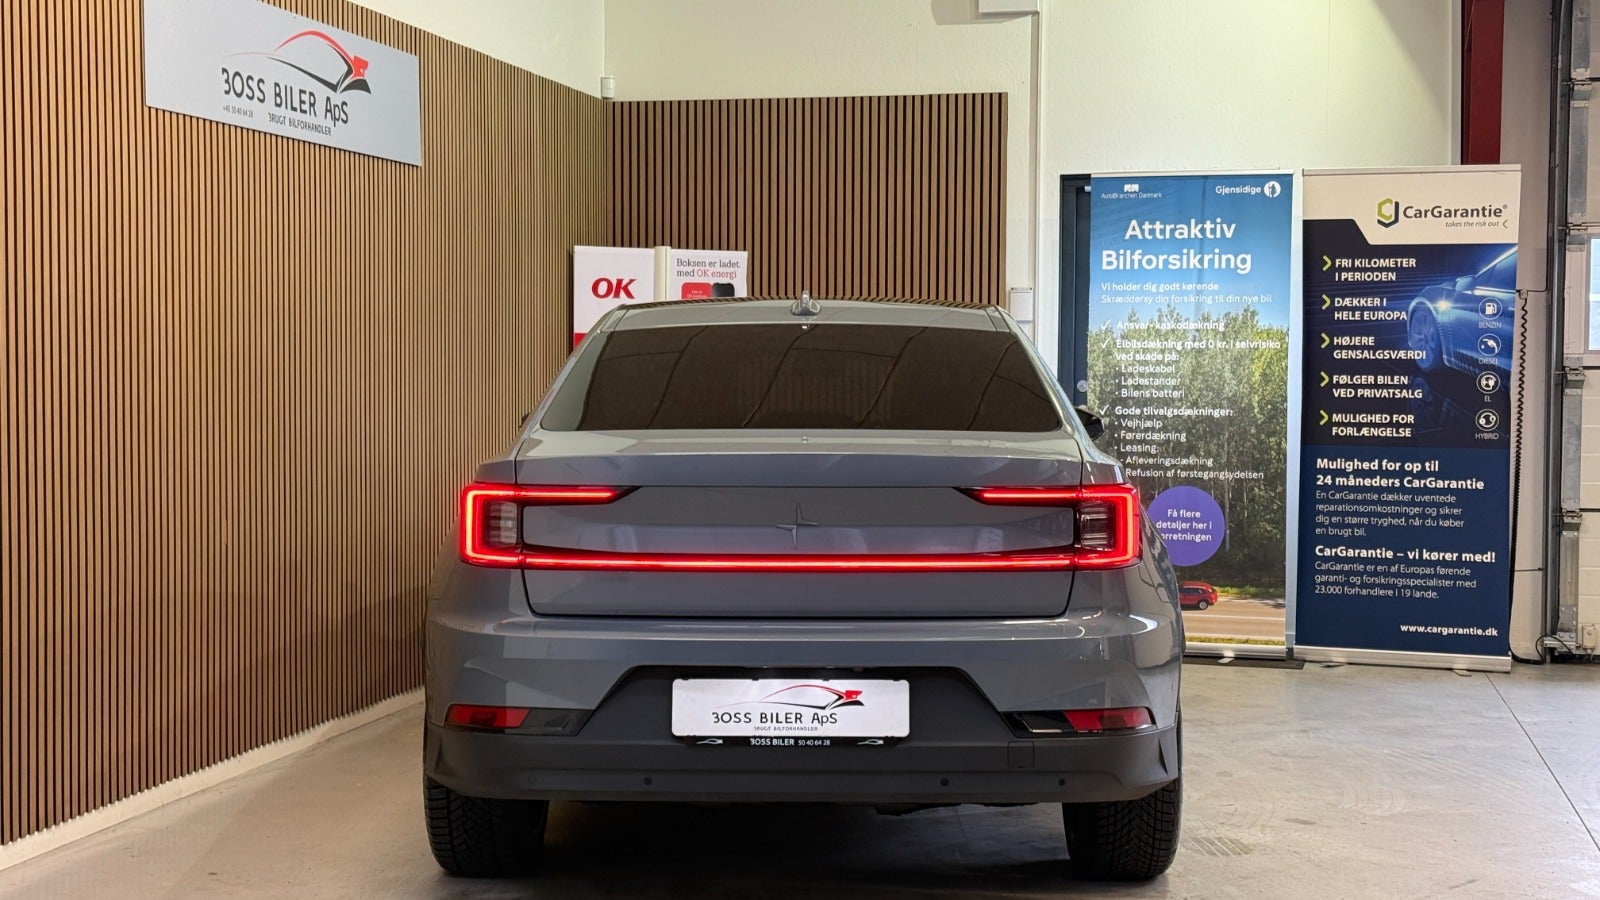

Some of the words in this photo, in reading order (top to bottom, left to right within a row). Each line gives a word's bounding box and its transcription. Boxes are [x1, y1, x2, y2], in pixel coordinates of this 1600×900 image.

[274, 82, 317, 118] BILER
[324, 96, 348, 127] ApS
[288, 117, 332, 136] BILFORHANDLER
[1215, 185, 1262, 196] Gjensidige
[1124, 218, 1236, 240] Attraktiv
[676, 258, 706, 268] Boksen
[1102, 248, 1252, 275] Bilforsikring
[1335, 258, 1352, 268] FRI
[1354, 258, 1416, 268] KILOMETER
[676, 269, 695, 277] med
[696, 269, 710, 277] OK
[711, 270, 737, 280] energi
[1335, 272, 1338, 281] I
[1341, 272, 1396, 281] PERIODEN
[592, 278, 637, 299] OK
[1112, 283, 1141, 291] holder
[1143, 283, 1157, 292] dig
[1158, 283, 1180, 293] godt
[1182, 283, 1219, 291] kørende
[1101, 295, 1154, 304] Skræddersy
[1156, 295, 1169, 303] din
[1171, 295, 1212, 304] forsikring
[1260, 294, 1272, 303] bil
[1334, 298, 1380, 307] DÆKKER
[1383, 298, 1386, 306] I
[1334, 311, 1361, 320] HELE
[1364, 311, 1408, 320] EUROPA
[1155, 321, 1225, 332] kaskodækning
[1116, 340, 1182, 350] Elbilsdækning
[1184, 340, 1206, 349] med
[1208, 340, 1214, 348] 0
[1216, 340, 1229, 349] kr.
[1235, 340, 1281, 349] selvrisiko
[1334, 336, 1375, 346] HØJERE
[1115, 352, 1134, 361] ved
[1135, 352, 1163, 361] skade
[1164, 351, 1180, 362] på:
[1333, 350, 1426, 360] GENSALGSVÆRDI
[1121, 364, 1175, 373] Ladeskabel
[1121, 377, 1181, 386] Ladestander
[1333, 375, 1374, 385] FØLGER
[1377, 375, 1408, 385] BILEN
[1121, 389, 1150, 398] Bilens
[1152, 389, 1185, 398] batteri
[1332, 388, 1355, 398] VED
[1357, 389, 1423, 399] PRIVATSALG
[1115, 406, 1141, 415] Gode
[1143, 406, 1233, 417] tilvalgsdækninger:
[1120, 419, 1162, 429] Vejhjælp
[1332, 414, 1390, 424] MULIGHED
[1393, 414, 1415, 424] FOR
[1120, 431, 1186, 442] Førerdækning
[1332, 427, 1412, 437] FORLÆNGELSE
[1125, 456, 1213, 468] Afleveringsdækning
[1316, 458, 1379, 472] Mulighed
[1382, 459, 1401, 470] for
[1404, 462, 1422, 473] op
[1425, 460, 1439, 472] til
[1125, 468, 1164, 478] Refusion
[1165, 469, 1175, 477] af
[1177, 470, 1264, 480] førstegangsydelsen
[1316, 475, 1332, 485] 24
[1336, 474, 1400, 487] måneders
[1404, 477, 1484, 490] CarGarantie
[1329, 491, 1379, 501] CarGarantie
[1380, 492, 1412, 501] dækker
[1415, 494, 1456, 503] uventede
[1168, 509, 1178, 518] Få
[1179, 509, 1200, 518] flere
[1316, 503, 1423, 516] reparationsomkostninger
[1425, 508, 1437, 516] og
[1439, 506, 1462, 515] sikrer
[1156, 521, 1191, 531] detaljer
[1193, 520, 1207, 530] her
[1316, 516, 1329, 524] dig
[1344, 516, 1368, 524] større
[1370, 516, 1407, 527] tryghed,
[1409, 517, 1423, 526] når
[1425, 518, 1437, 526] du
[1439, 518, 1464, 528] køber
[1329, 527, 1352, 537] brugt
[1354, 527, 1366, 536] bil.
[1315, 545, 1394, 559] CarGarantie
[1407, 549, 1419, 559] vi
[1423, 549, 1458, 561] kører
[1462, 551, 1496, 563] med!
[1315, 561, 1364, 572] CarGarantie
[1390, 564, 1399, 573] af
[1400, 565, 1434, 575] Europas
[1436, 566, 1471, 575] førende
[1314, 574, 1348, 584] garanti-
[1350, 577, 1361, 585] og
[1363, 575, 1454, 587] forsikringsspecialister
[1456, 579, 1476, 588] med
[1314, 586, 1342, 594] 23.000
[1344, 586, 1393, 597] forhandlere
[1401, 589, 1410, 597] 19
[1412, 589, 1439, 599] lande.
[1400, 624, 1498, 636] www.cargarantie.dk
[760, 711, 803, 724] BILER
[811, 712, 838, 726] ApS
